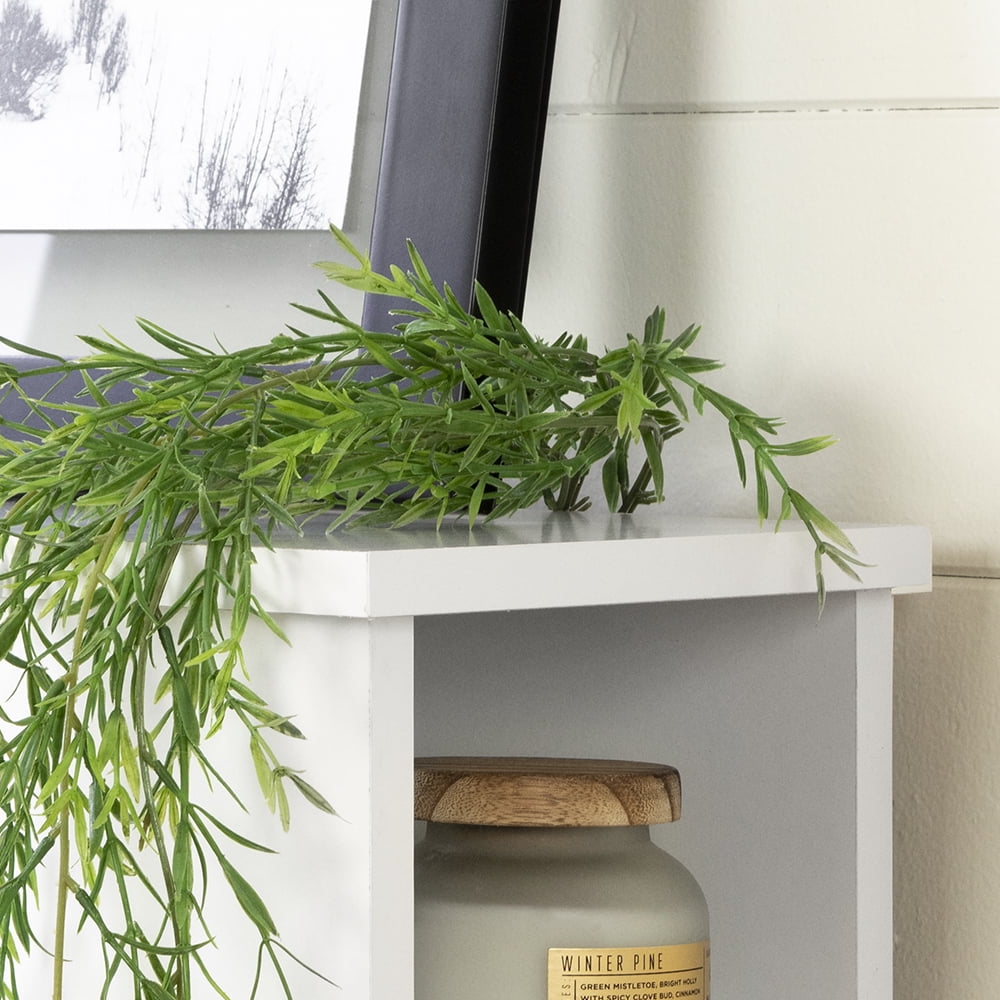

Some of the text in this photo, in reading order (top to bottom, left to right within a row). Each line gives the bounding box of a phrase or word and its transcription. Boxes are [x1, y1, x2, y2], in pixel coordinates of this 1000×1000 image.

[561, 953, 663, 972] WINTER PINE
[580, 983, 611, 991] GREEN
[612, 981, 658, 991] MISTLETOE,
[659, 979, 682, 989] BRIGHT
[632, 993, 658, 1000] CLOVE
